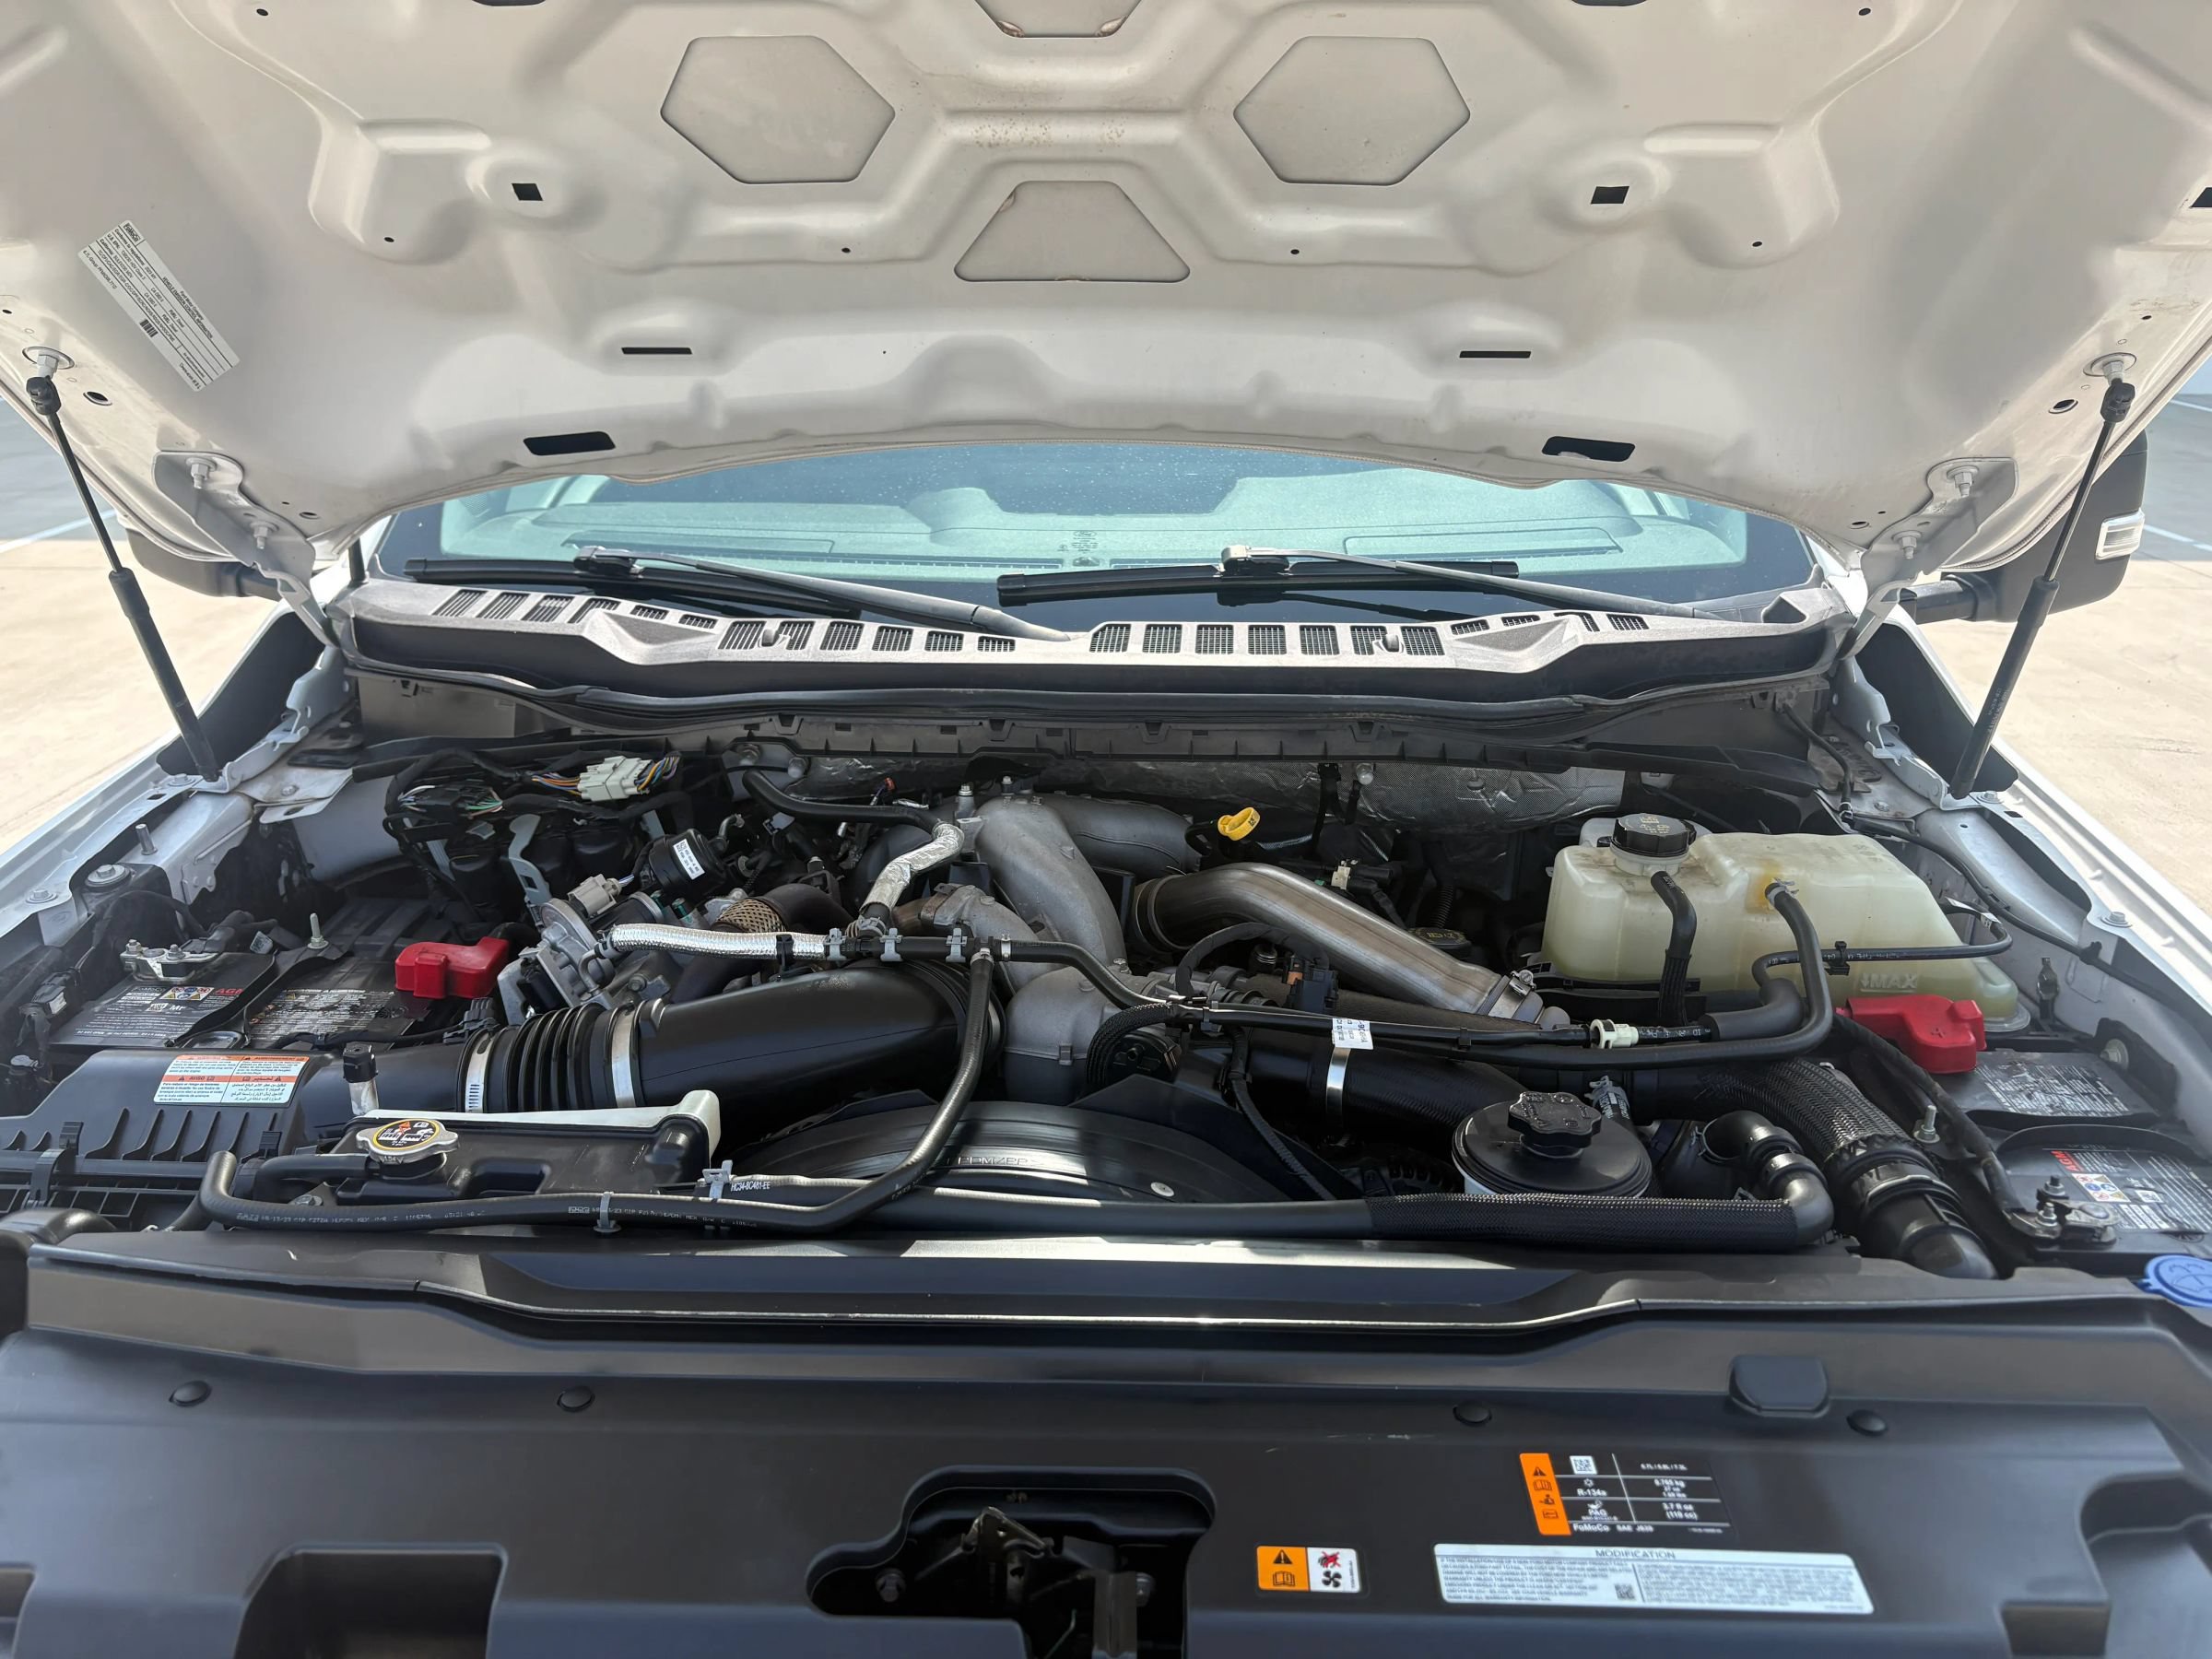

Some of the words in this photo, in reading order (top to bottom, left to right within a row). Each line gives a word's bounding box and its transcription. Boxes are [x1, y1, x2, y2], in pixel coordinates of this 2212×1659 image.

[122, 222, 141, 242] FoMoCo
[1870, 973, 1917, 989] MAX
[2050, 1150, 2080, 1171] AGM
[1576, 1488, 1607, 1497] R-134a
[1572, 1523, 1610, 1532] FoMoCo
[1594, 1549, 1677, 1559] MODIFICATION
